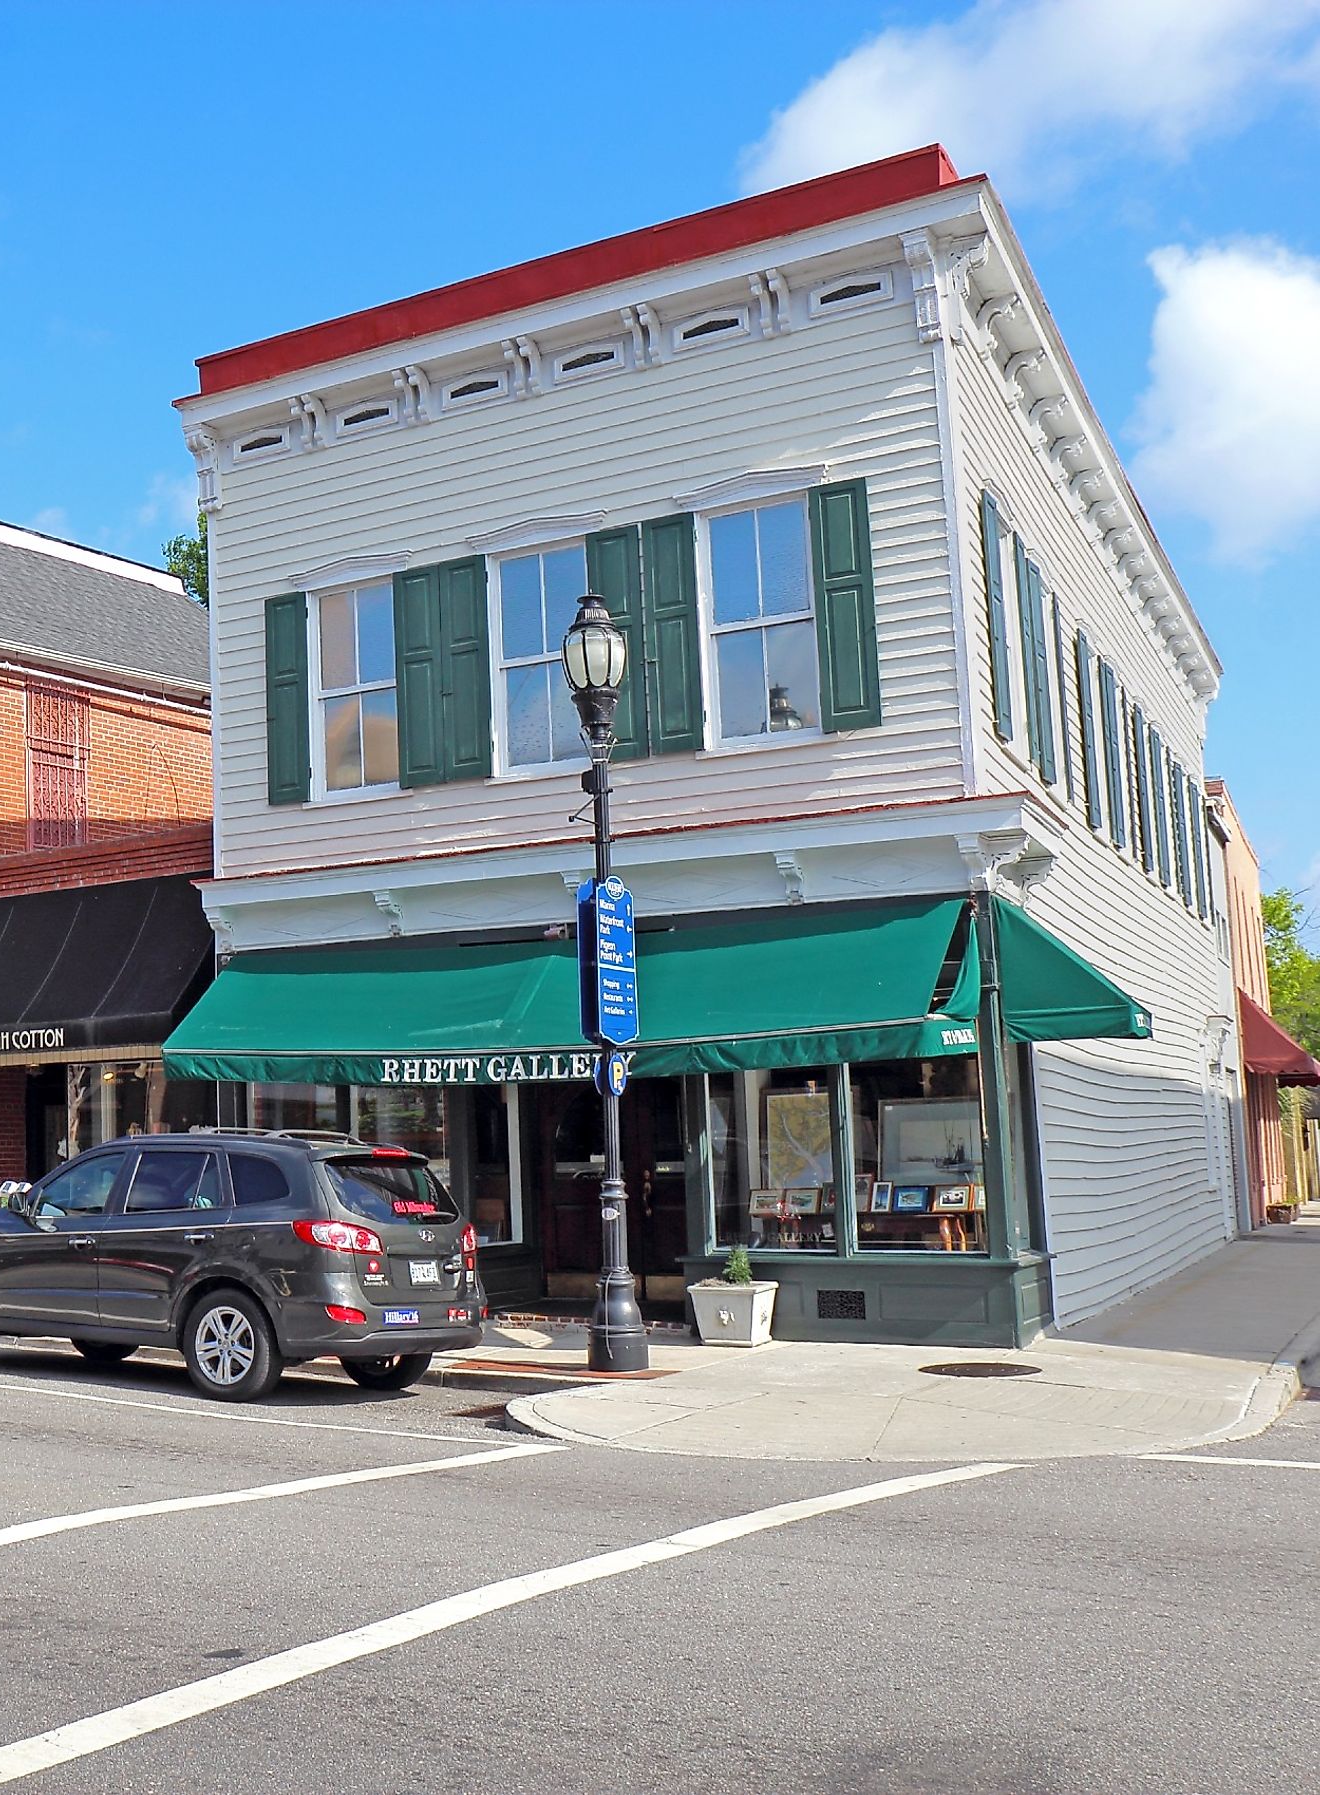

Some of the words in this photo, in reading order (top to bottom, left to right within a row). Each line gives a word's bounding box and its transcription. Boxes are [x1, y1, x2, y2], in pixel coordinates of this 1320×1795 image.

[599, 914, 624, 928] Waterfront
[599, 923, 611, 935] Park
[12, 1028, 64, 1050] COTTON
[380, 1058, 480, 1083] RHETT
